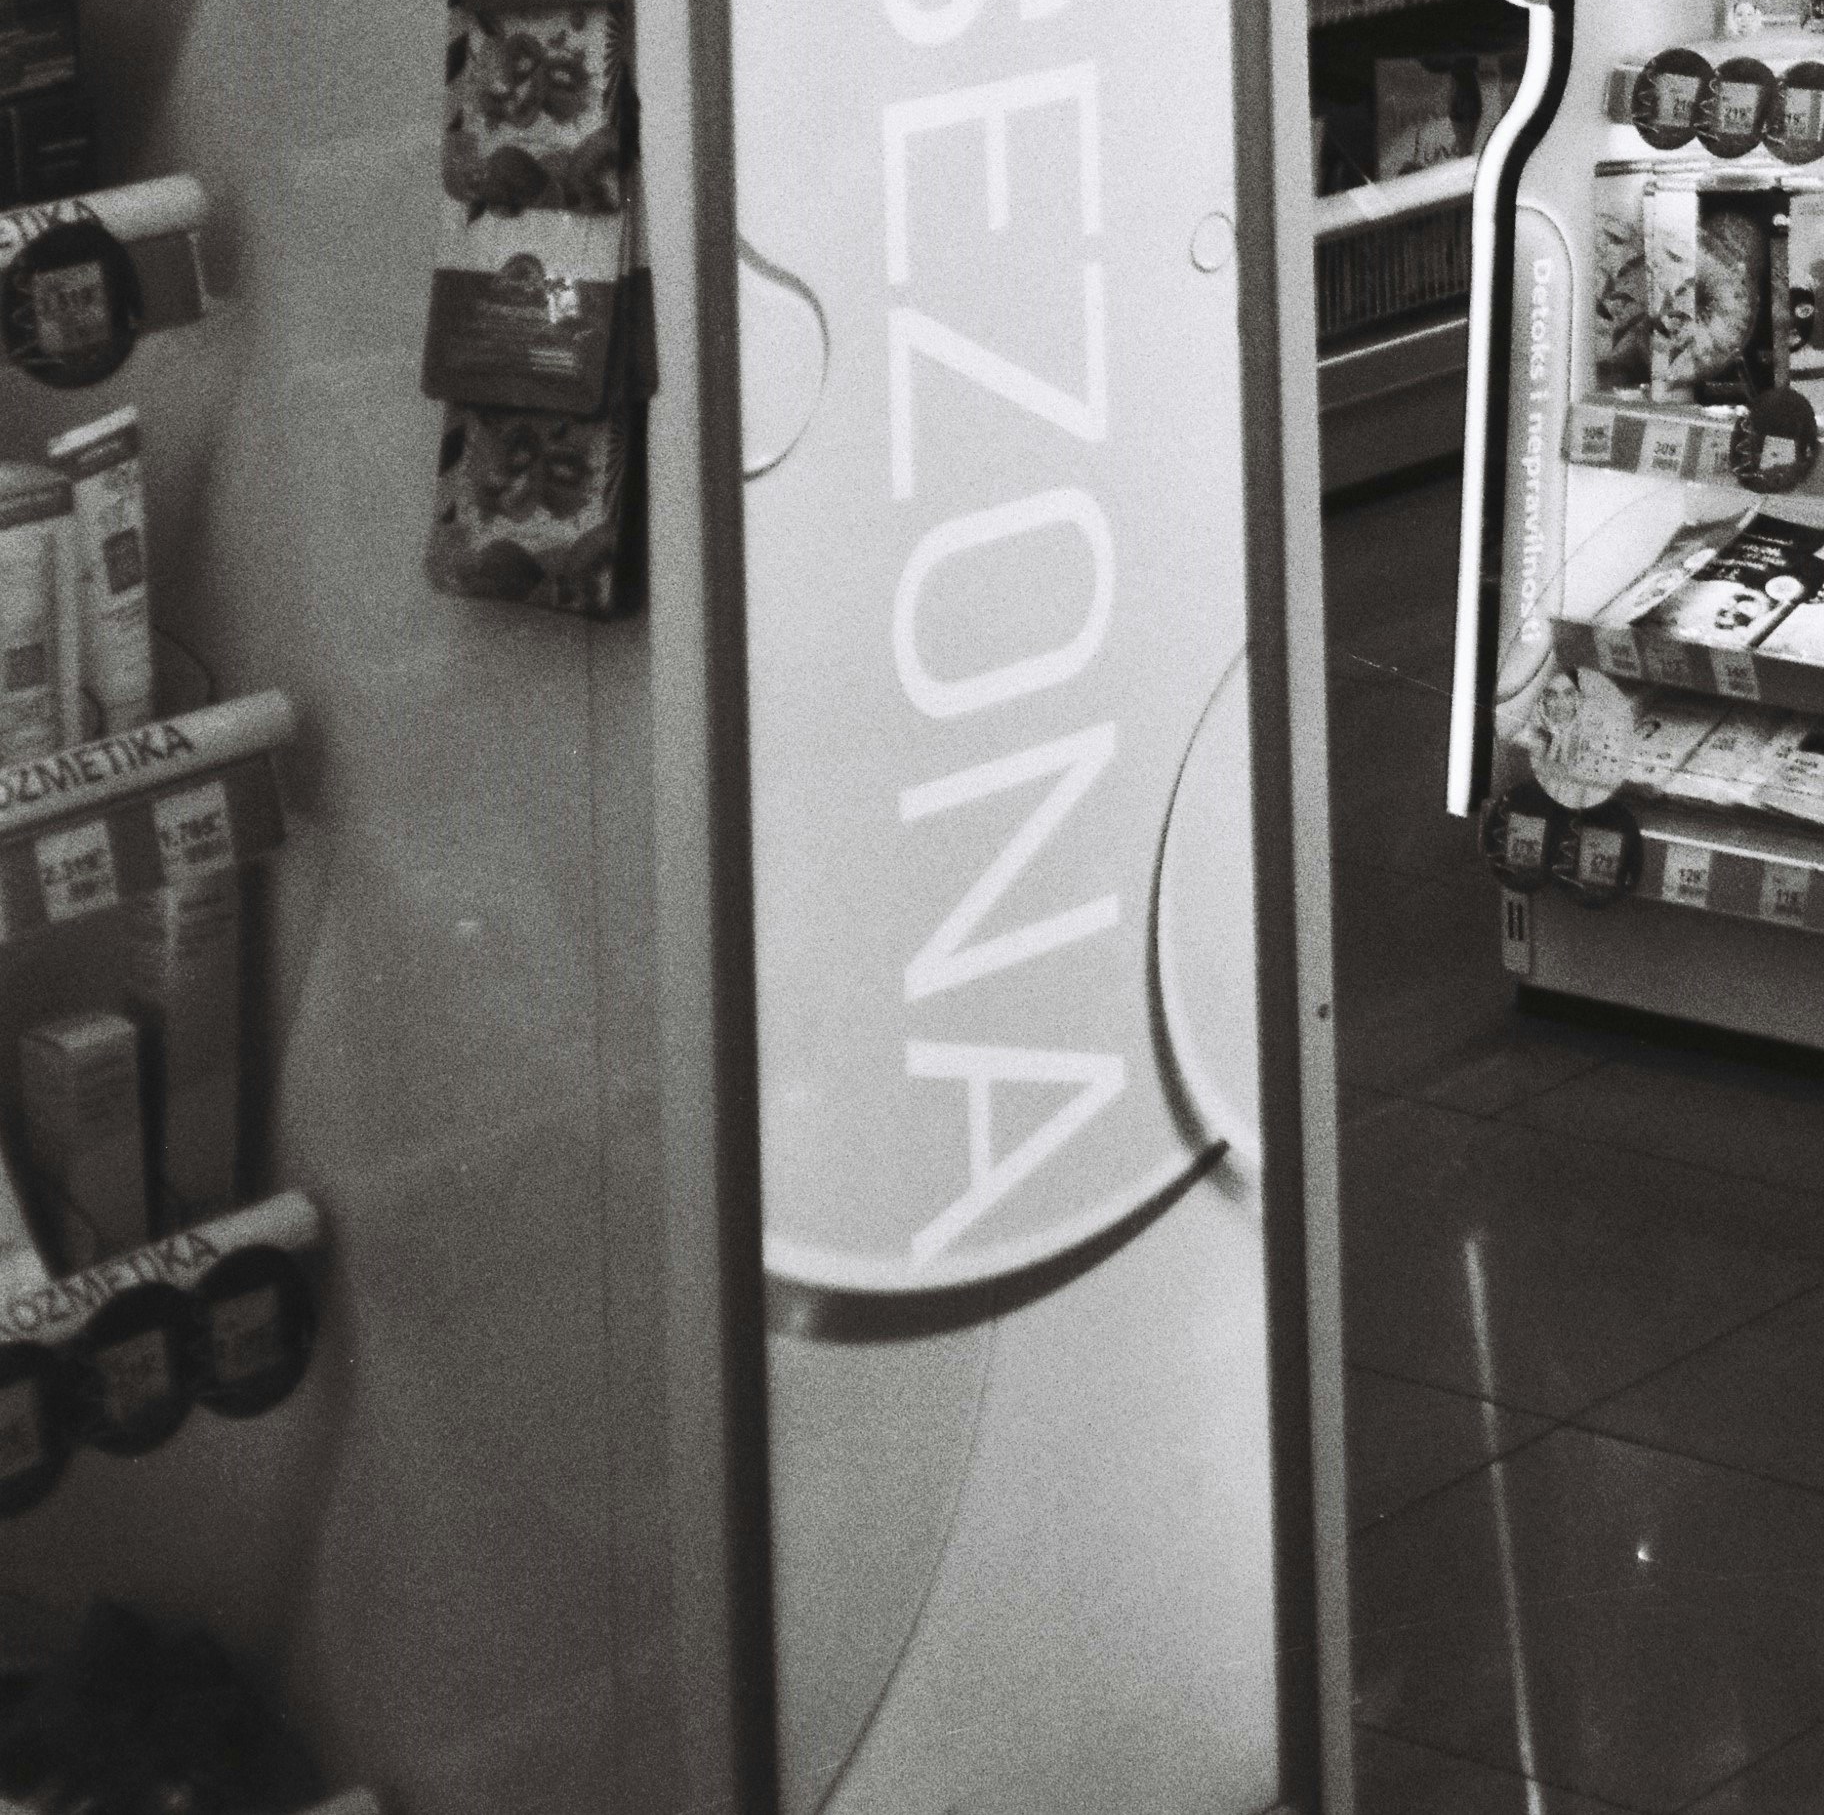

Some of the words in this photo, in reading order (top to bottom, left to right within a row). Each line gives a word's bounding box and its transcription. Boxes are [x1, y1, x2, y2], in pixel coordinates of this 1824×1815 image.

[1530, 257, 1555, 380] Detoks
[1529, 390, 1550, 402] i
[1520, 412, 1546, 643] nepravilnosti
